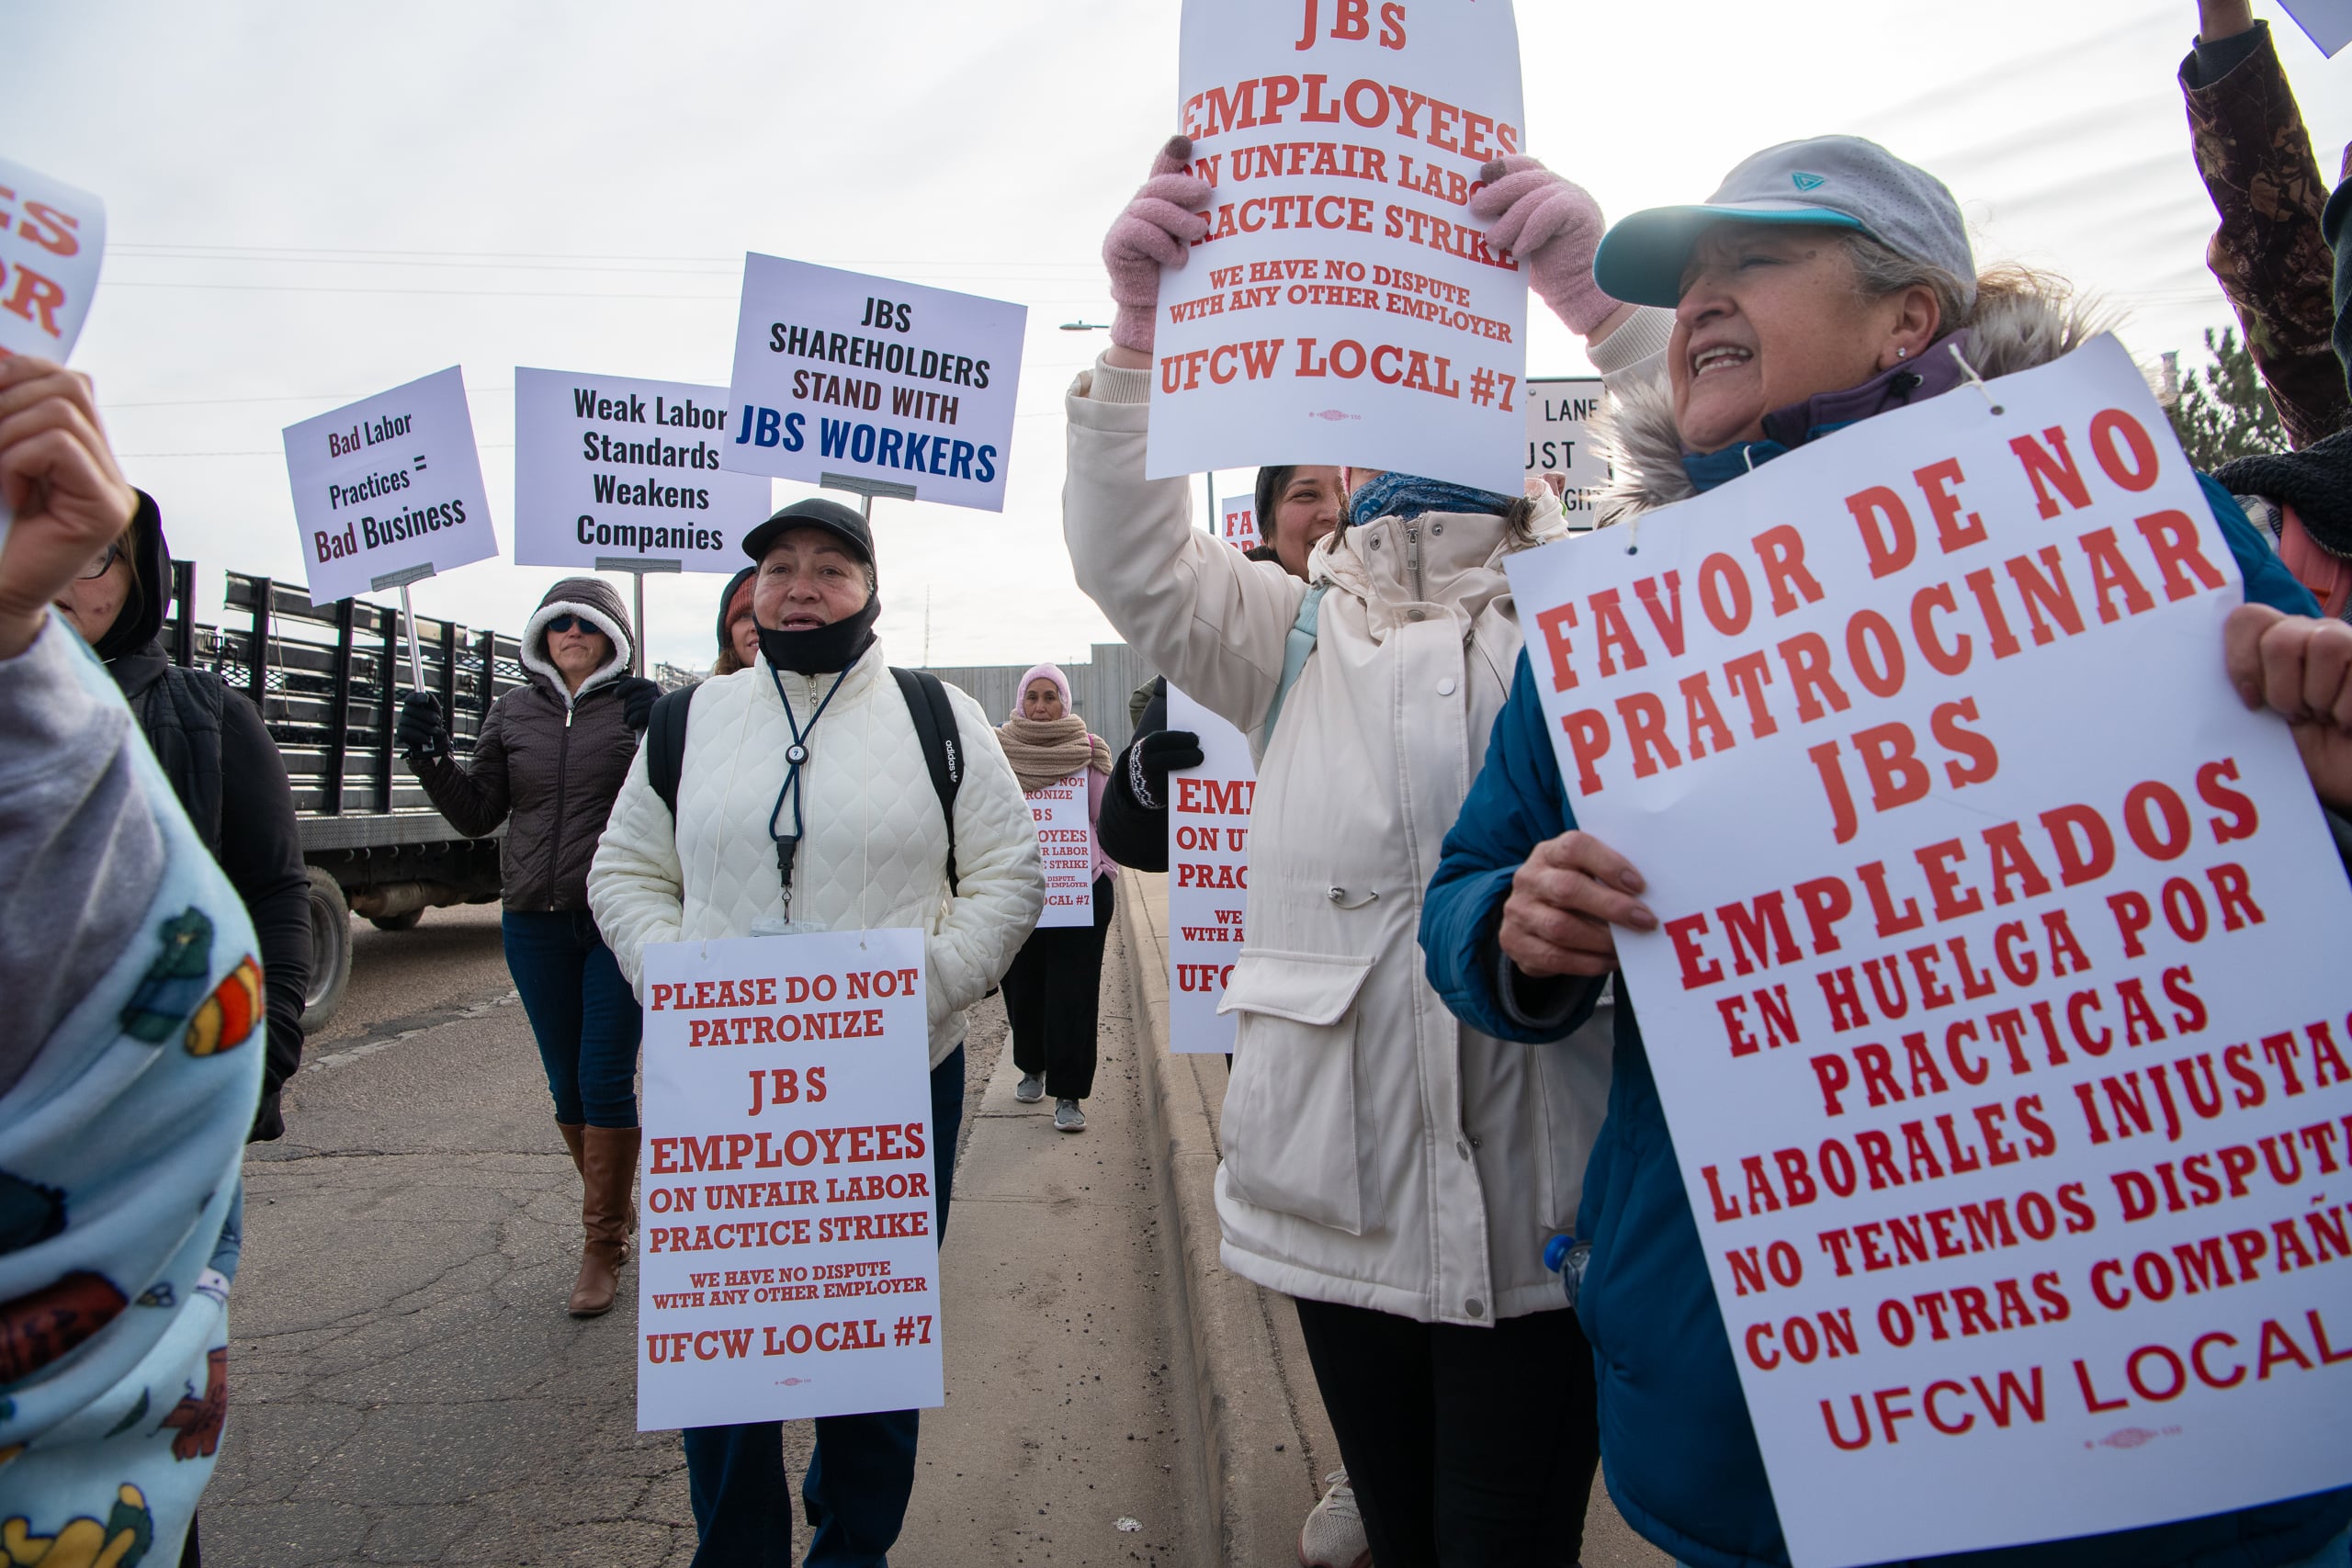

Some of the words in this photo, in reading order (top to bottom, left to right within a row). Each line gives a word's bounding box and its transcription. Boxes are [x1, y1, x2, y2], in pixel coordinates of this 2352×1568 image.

[1295, 0, 1406, 51] JBS
[1182, 74, 1518, 164] EMPLOYEES
[1231, 142, 1387, 183] UNFAIR
[1191, 195, 1374, 247] RACTICE
[1385, 204, 1519, 272] STRIKE
[1210, 265, 1243, 289] WE
[1250, 260, 1317, 282] HAVE
[1325, 260, 1365, 281] NO
[1373, 265, 1469, 308] DISPUTE
[861, 298, 911, 333] JBS
[1170, 294, 1225, 323] WITH
[1229, 286, 1281, 310] ANY
[1288, 285, 1380, 310] OTHER
[1386, 293, 1512, 344] EMPLOYER
[770, 323, 989, 389] SHAREHOLDERS
[1161, 339, 1284, 393] UFCW
[1295, 338, 1459, 399] LOCAL
[1471, 367, 1515, 412] #7
[574, 389, 646, 423] Weak
[657, 397, 728, 430] Labor
[793, 369, 881, 411] STAND
[893, 386, 958, 424] WITH
[329, 425, 361, 457] Bad
[365, 414, 412, 446] Labor
[584, 432, 719, 469] Standards
[736, 405, 805, 452] JBS
[821, 418, 997, 482] WORKERS
[330, 470, 410, 510] Practices
[414, 456, 426, 470] =
[594, 474, 708, 509] Weakens
[314, 522, 357, 563] Bad
[362, 500, 466, 549] Business
[578, 515, 722, 553] Companies
[1227, 511, 1257, 536] FA
[1536, 525, 1825, 693] FAVOR
[1845, 457, 1987, 580] DE
[2008, 409, 2158, 520] NO
[1561, 510, 2226, 796] PRATROCINAR
[945, 739, 956, 771] adidas
[1808, 696, 1998, 844] JBS
[1024, 790, 1073, 800] RONIZE
[1059, 777, 1085, 787] NOT
[1032, 808, 1053, 821] BS
[1038, 829, 1088, 842] OYEES
[1052, 847, 1089, 855] LABOR
[1177, 827, 1219, 851] ON
[1049, 860, 1089, 869] STRIKE
[1663, 758, 2258, 990] EMPLEADOS
[1044, 895, 1074, 906] CAL
[1076, 895, 1091, 906] #7
[1215, 910, 1242, 924] WE
[1182, 927, 1228, 942] WITH
[1716, 984, 1799, 1057] EN
[1816, 909, 2091, 1032] HUELGA
[2106, 863, 2264, 958] POR
[651, 978, 776, 1010] PLEASE
[786, 975, 837, 1003] DO
[846, 969, 918, 999] NOT
[690, 1010, 884, 1047] PATRONIZE
[1810, 965, 2207, 1116] PRACTICAS
[749, 1066, 826, 1116] JBS
[1702, 1095, 2055, 1222] LABORALES
[2074, 1009, 2352, 1144] INJUSTA
[650, 1122, 925, 1174] EMPLOYEES
[650, 1187, 696, 1213] ON
[705, 1180, 819, 1210] UNFAIR
[827, 1173, 929, 1202] LABOR
[650, 1219, 810, 1253] PRACTICE
[820, 1212, 928, 1242] STRIKE
[1725, 1240, 1802, 1296] NO
[1818, 1182, 2095, 1276] TENEMOS
[652, 1292, 705, 1309] WITH
[709, 1289, 750, 1306] ANY
[754, 1285, 820, 1303] OTHER
[823, 1277, 927, 1298] EMPLOYER
[690, 1272, 719, 1288] WE
[725, 1269, 774, 1286] HAVE
[779, 1267, 808, 1282] NO
[812, 1261, 890, 1280] DISPUTE
[1746, 1308, 1859, 1371] CON
[1878, 1271, 2069, 1347] OTRAS
[2090, 1192, 2352, 1310] COMPAÑ
[647, 1328, 754, 1363] UFCW
[763, 1319, 885, 1356] LOCAL
[894, 1315, 932, 1346] #7
[1820, 1367, 2044, 1450] UFCW
[2073, 1310, 2352, 1413] LOCAL
